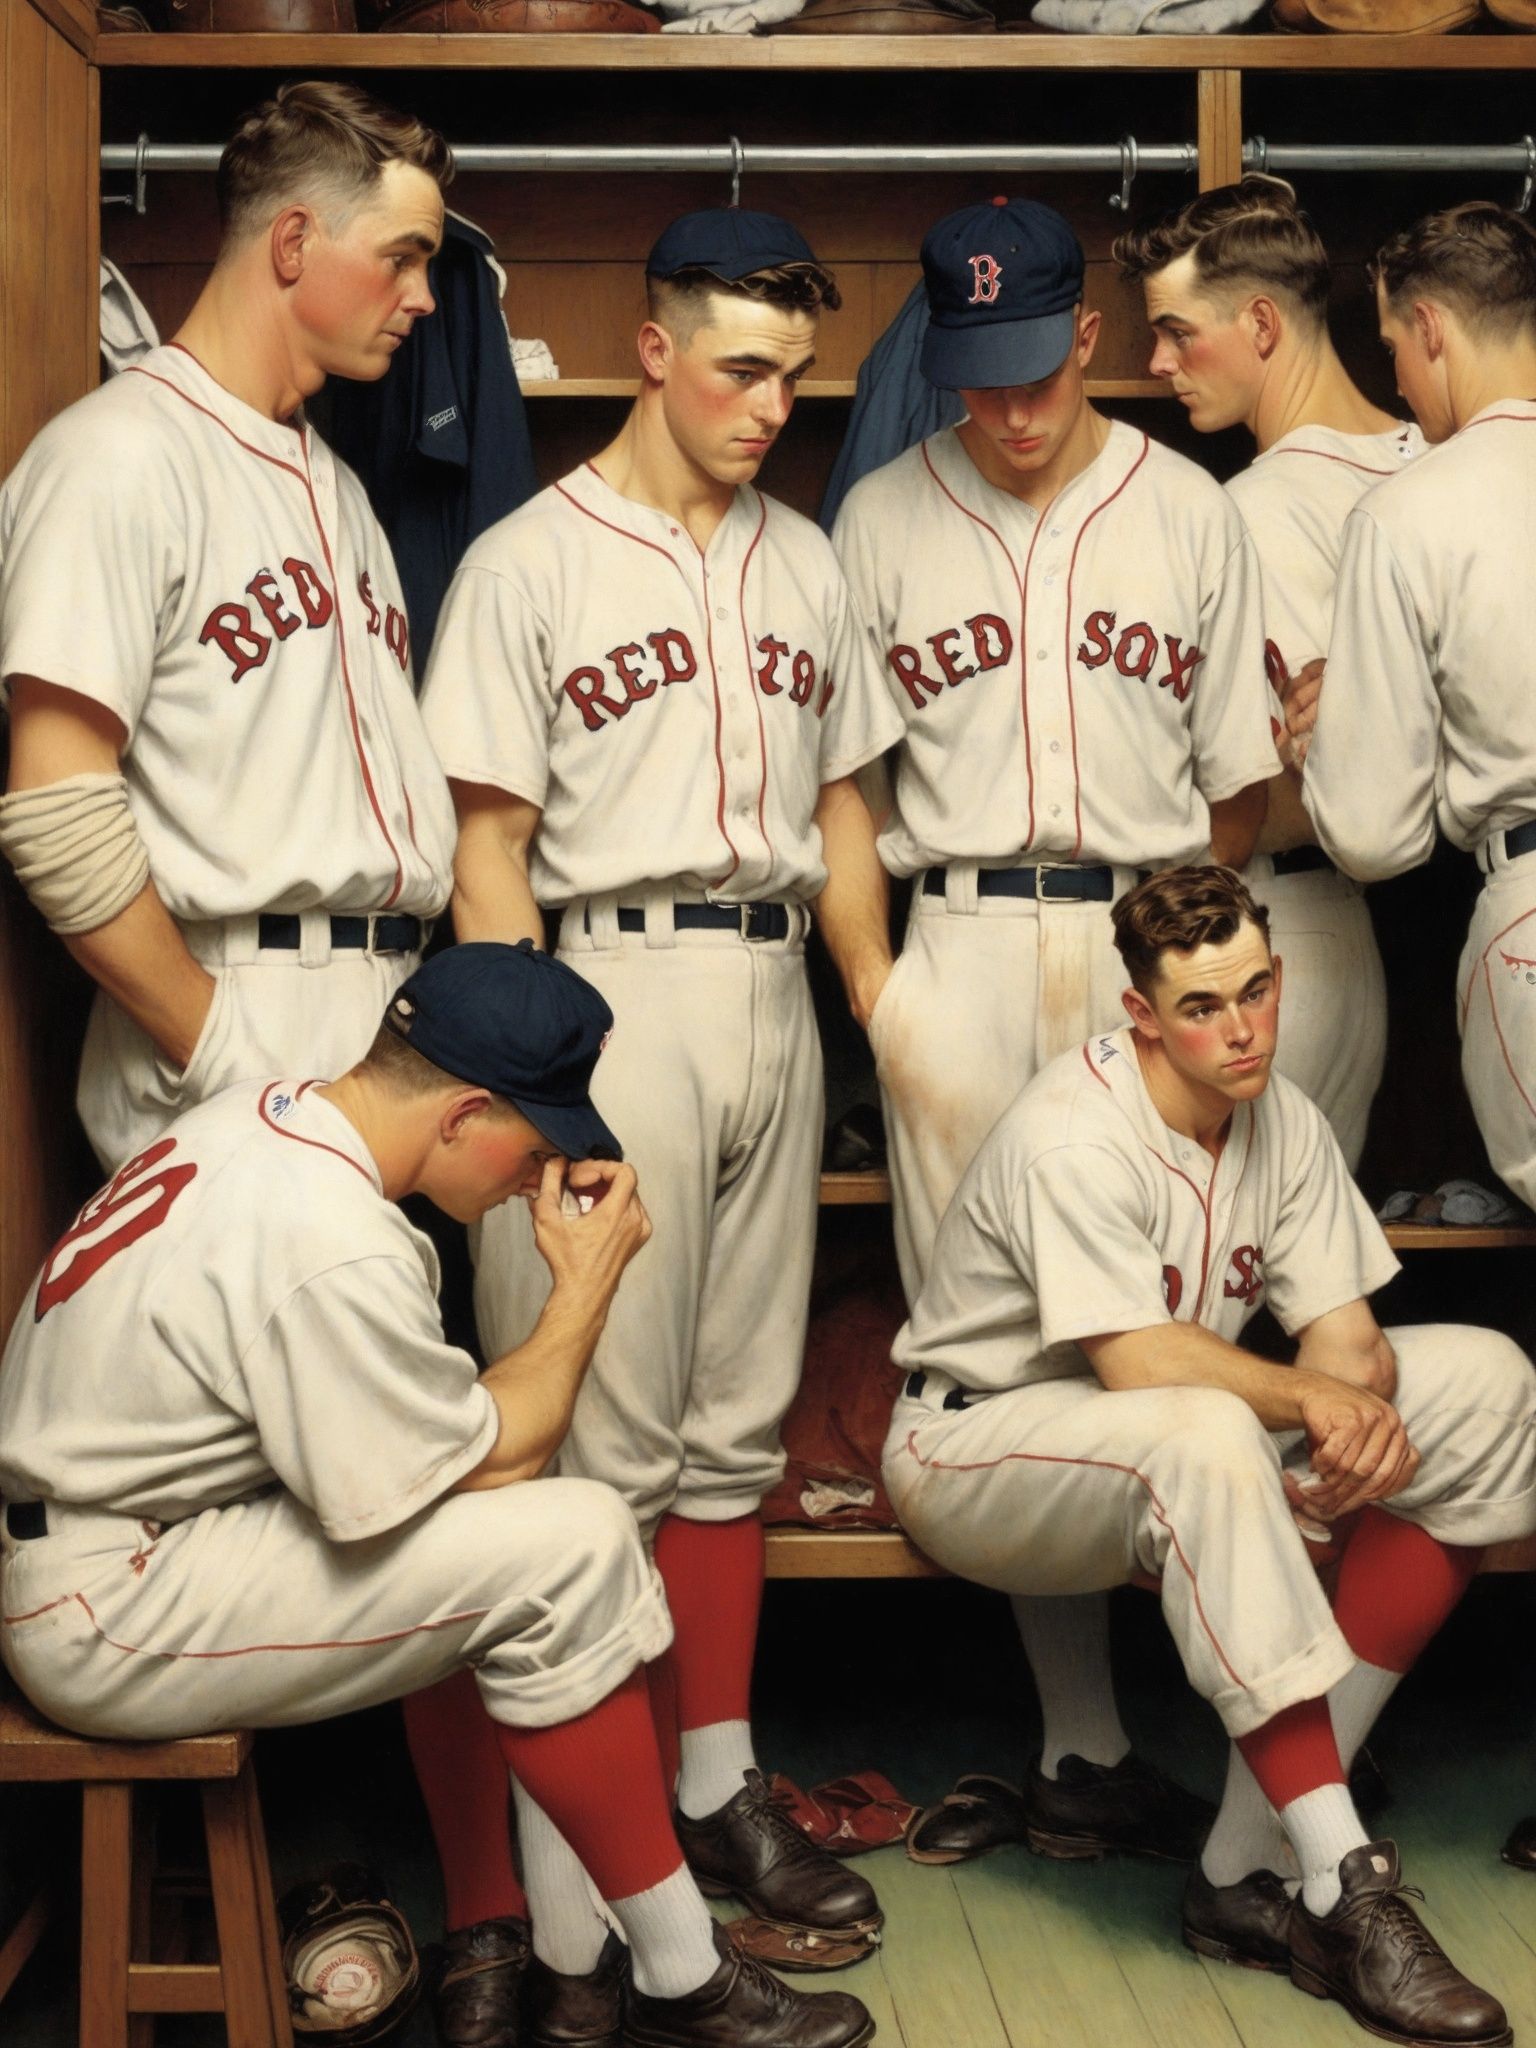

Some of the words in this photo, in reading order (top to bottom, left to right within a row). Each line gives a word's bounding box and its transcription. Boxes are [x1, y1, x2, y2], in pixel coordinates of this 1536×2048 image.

[967, 254, 1002, 304] B
[564, 628, 697, 731] RED
[888, 613, 1013, 710] RED
[1077, 610, 1204, 702] SOX
